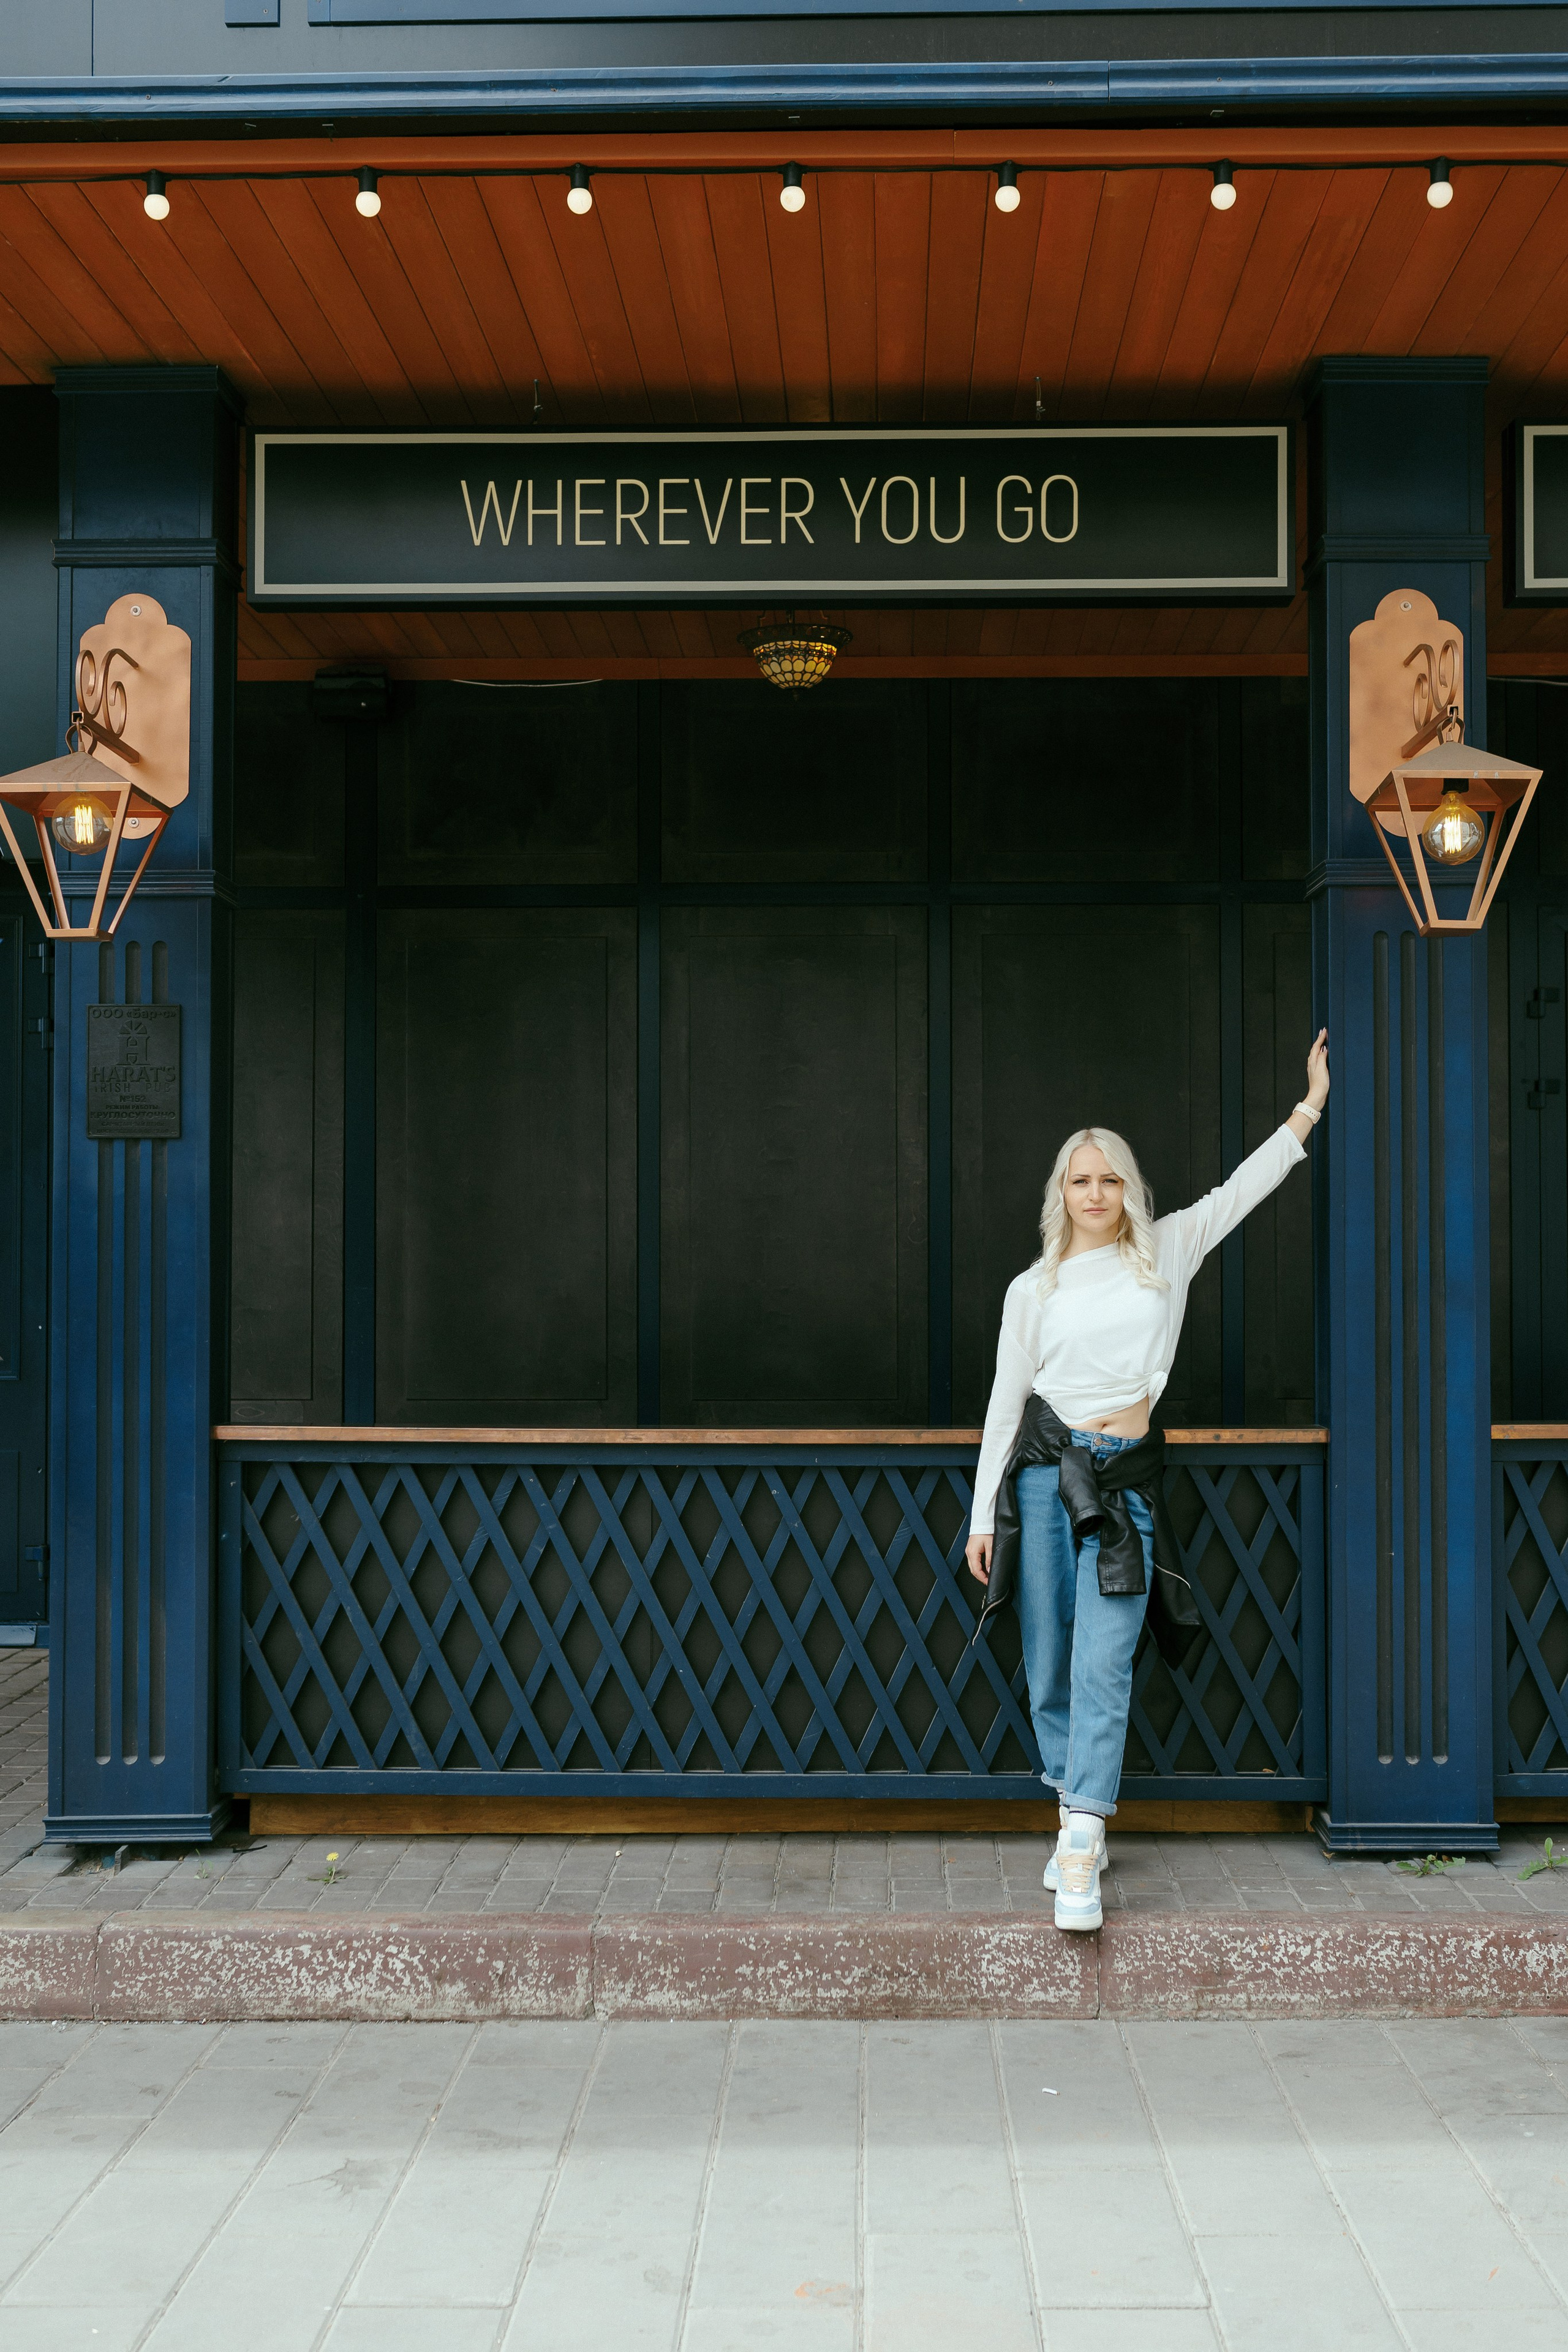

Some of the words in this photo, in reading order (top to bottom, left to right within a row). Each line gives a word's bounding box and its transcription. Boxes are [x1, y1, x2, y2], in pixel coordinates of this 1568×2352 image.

[461, 478, 815, 546] WHEREVER
[839, 476, 965, 543] YOU
[997, 475, 1079, 543] GO
[92, 1008, 123, 1019] ООО
[91, 1066, 176, 1083] HARAT'S
[145, 1082, 172, 1093] PUB
